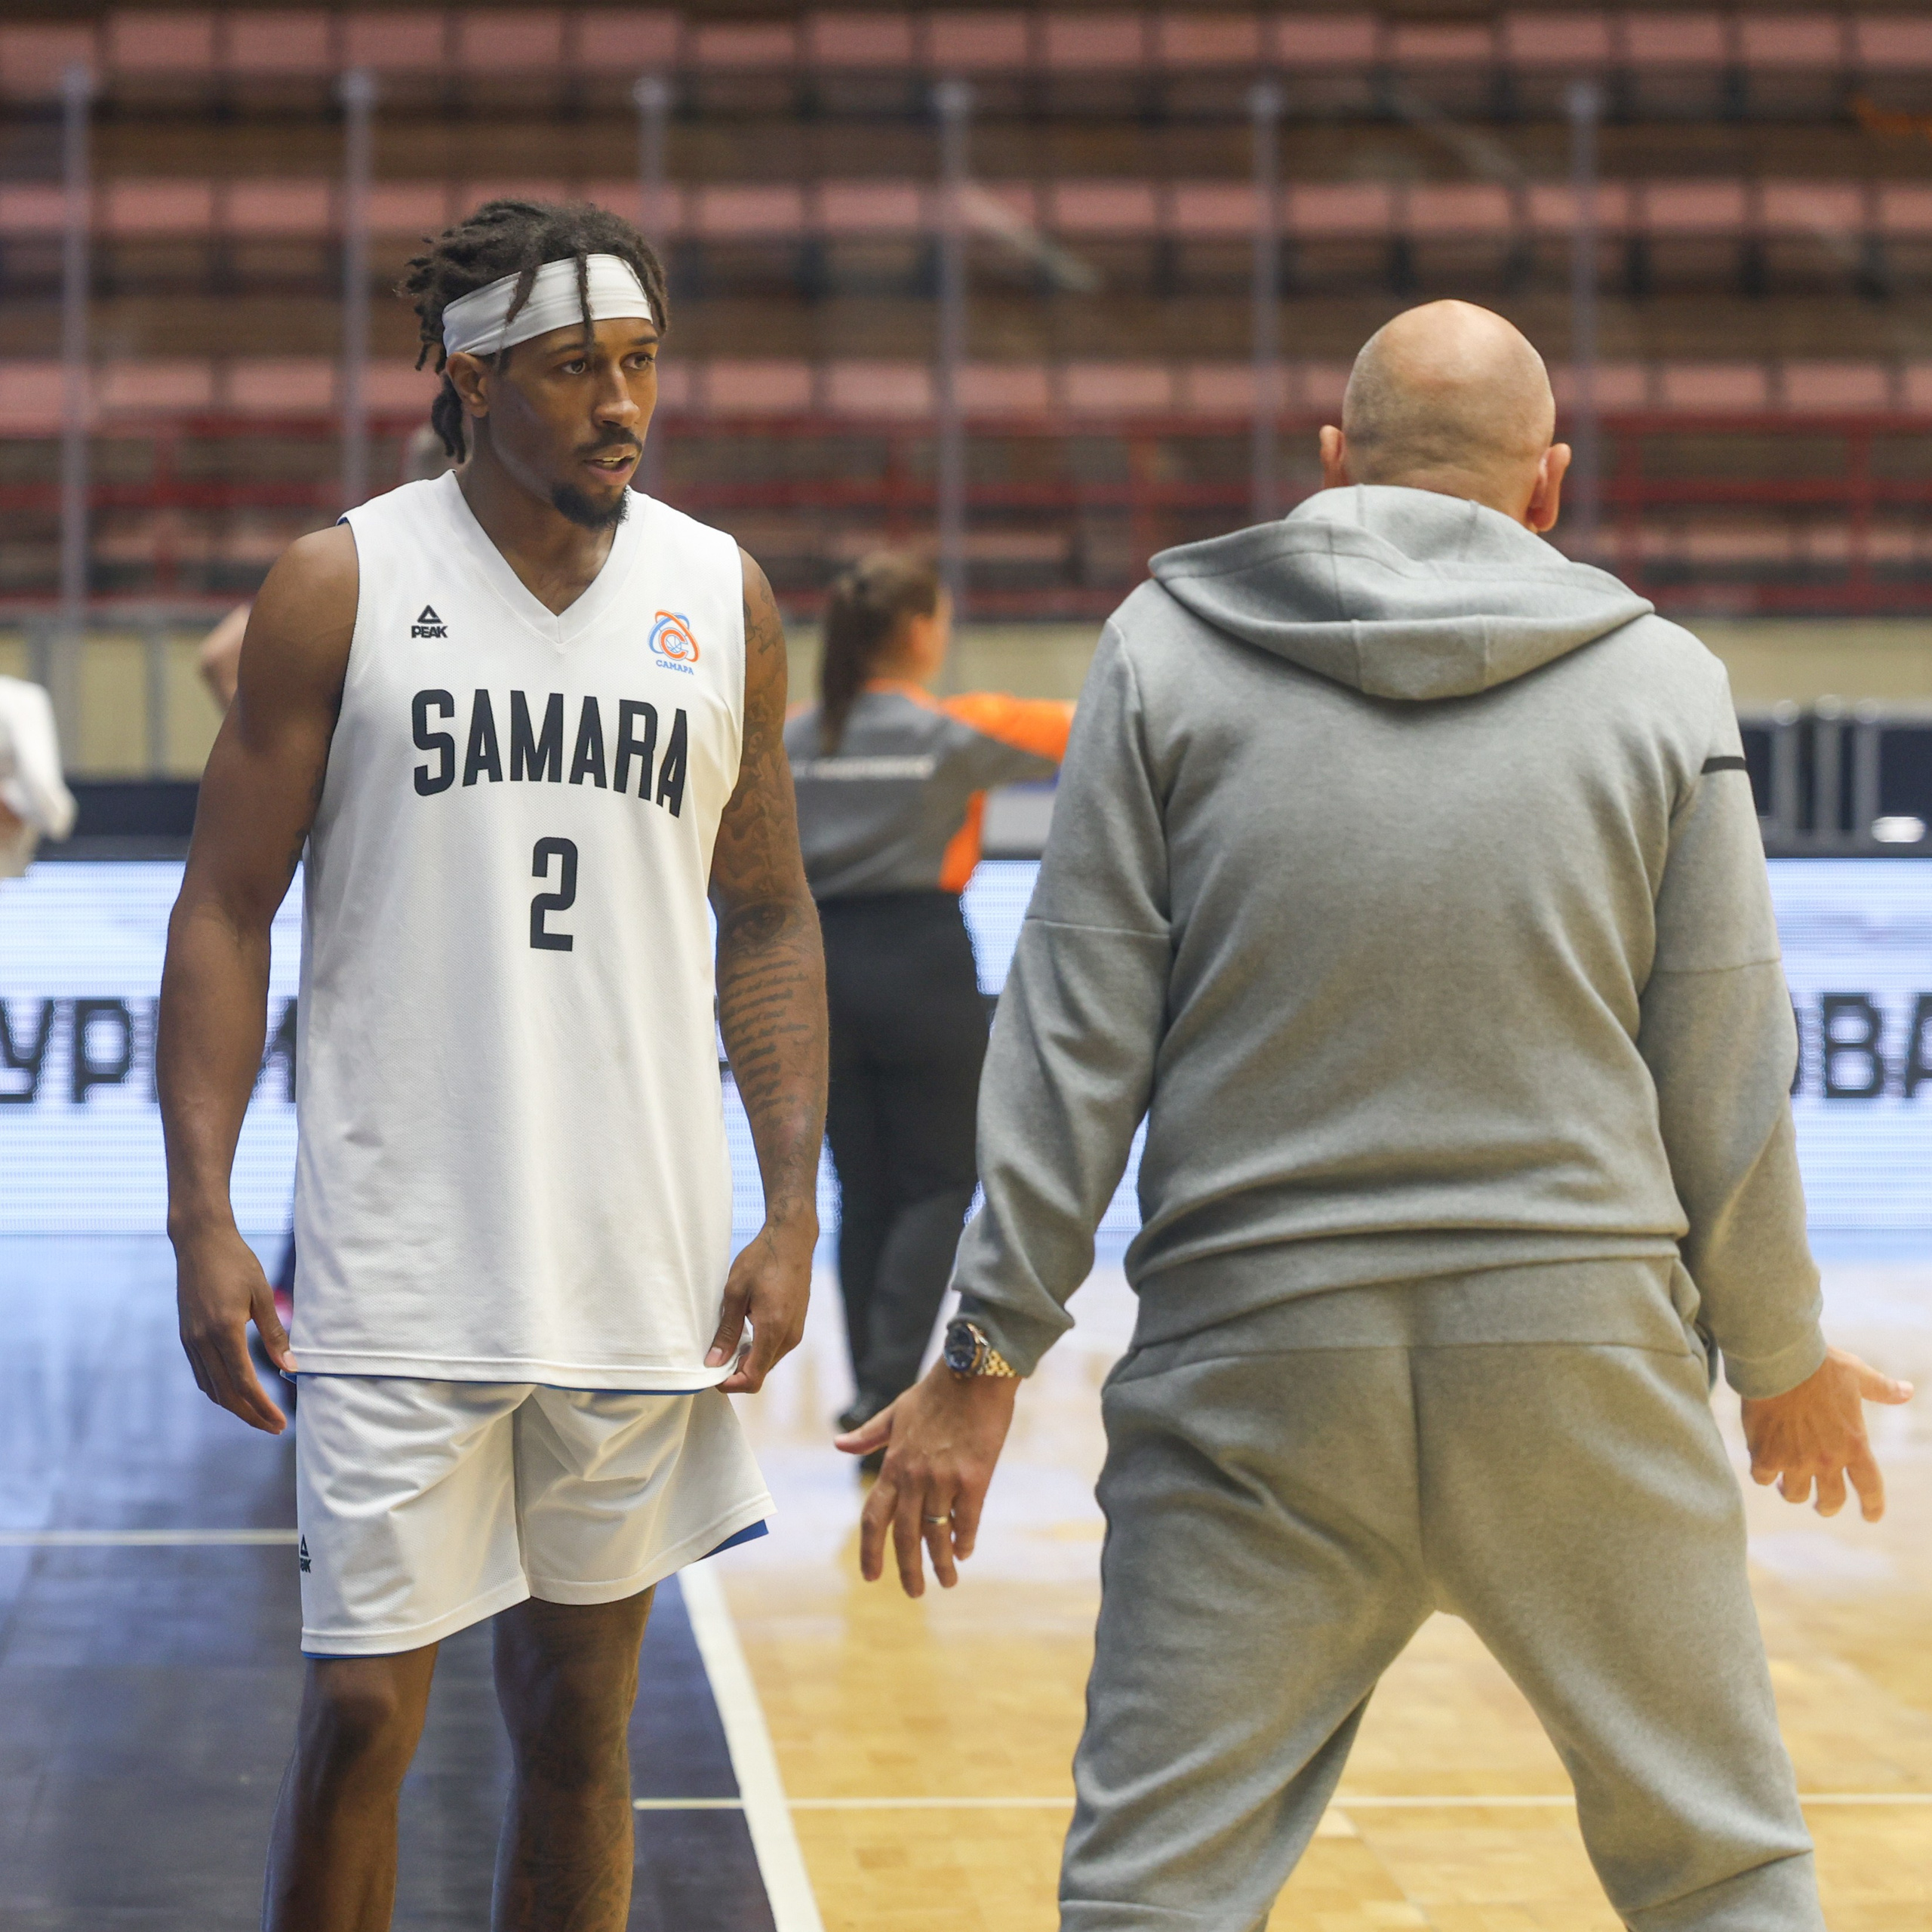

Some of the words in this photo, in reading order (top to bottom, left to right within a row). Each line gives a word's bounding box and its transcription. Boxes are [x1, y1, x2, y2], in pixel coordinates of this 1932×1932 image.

[411, 625, 448, 638] PEAK
[655, 659, 695, 675] САМАРА
[411, 688, 688, 819] SAMARA
[530, 836, 578, 952] 2
